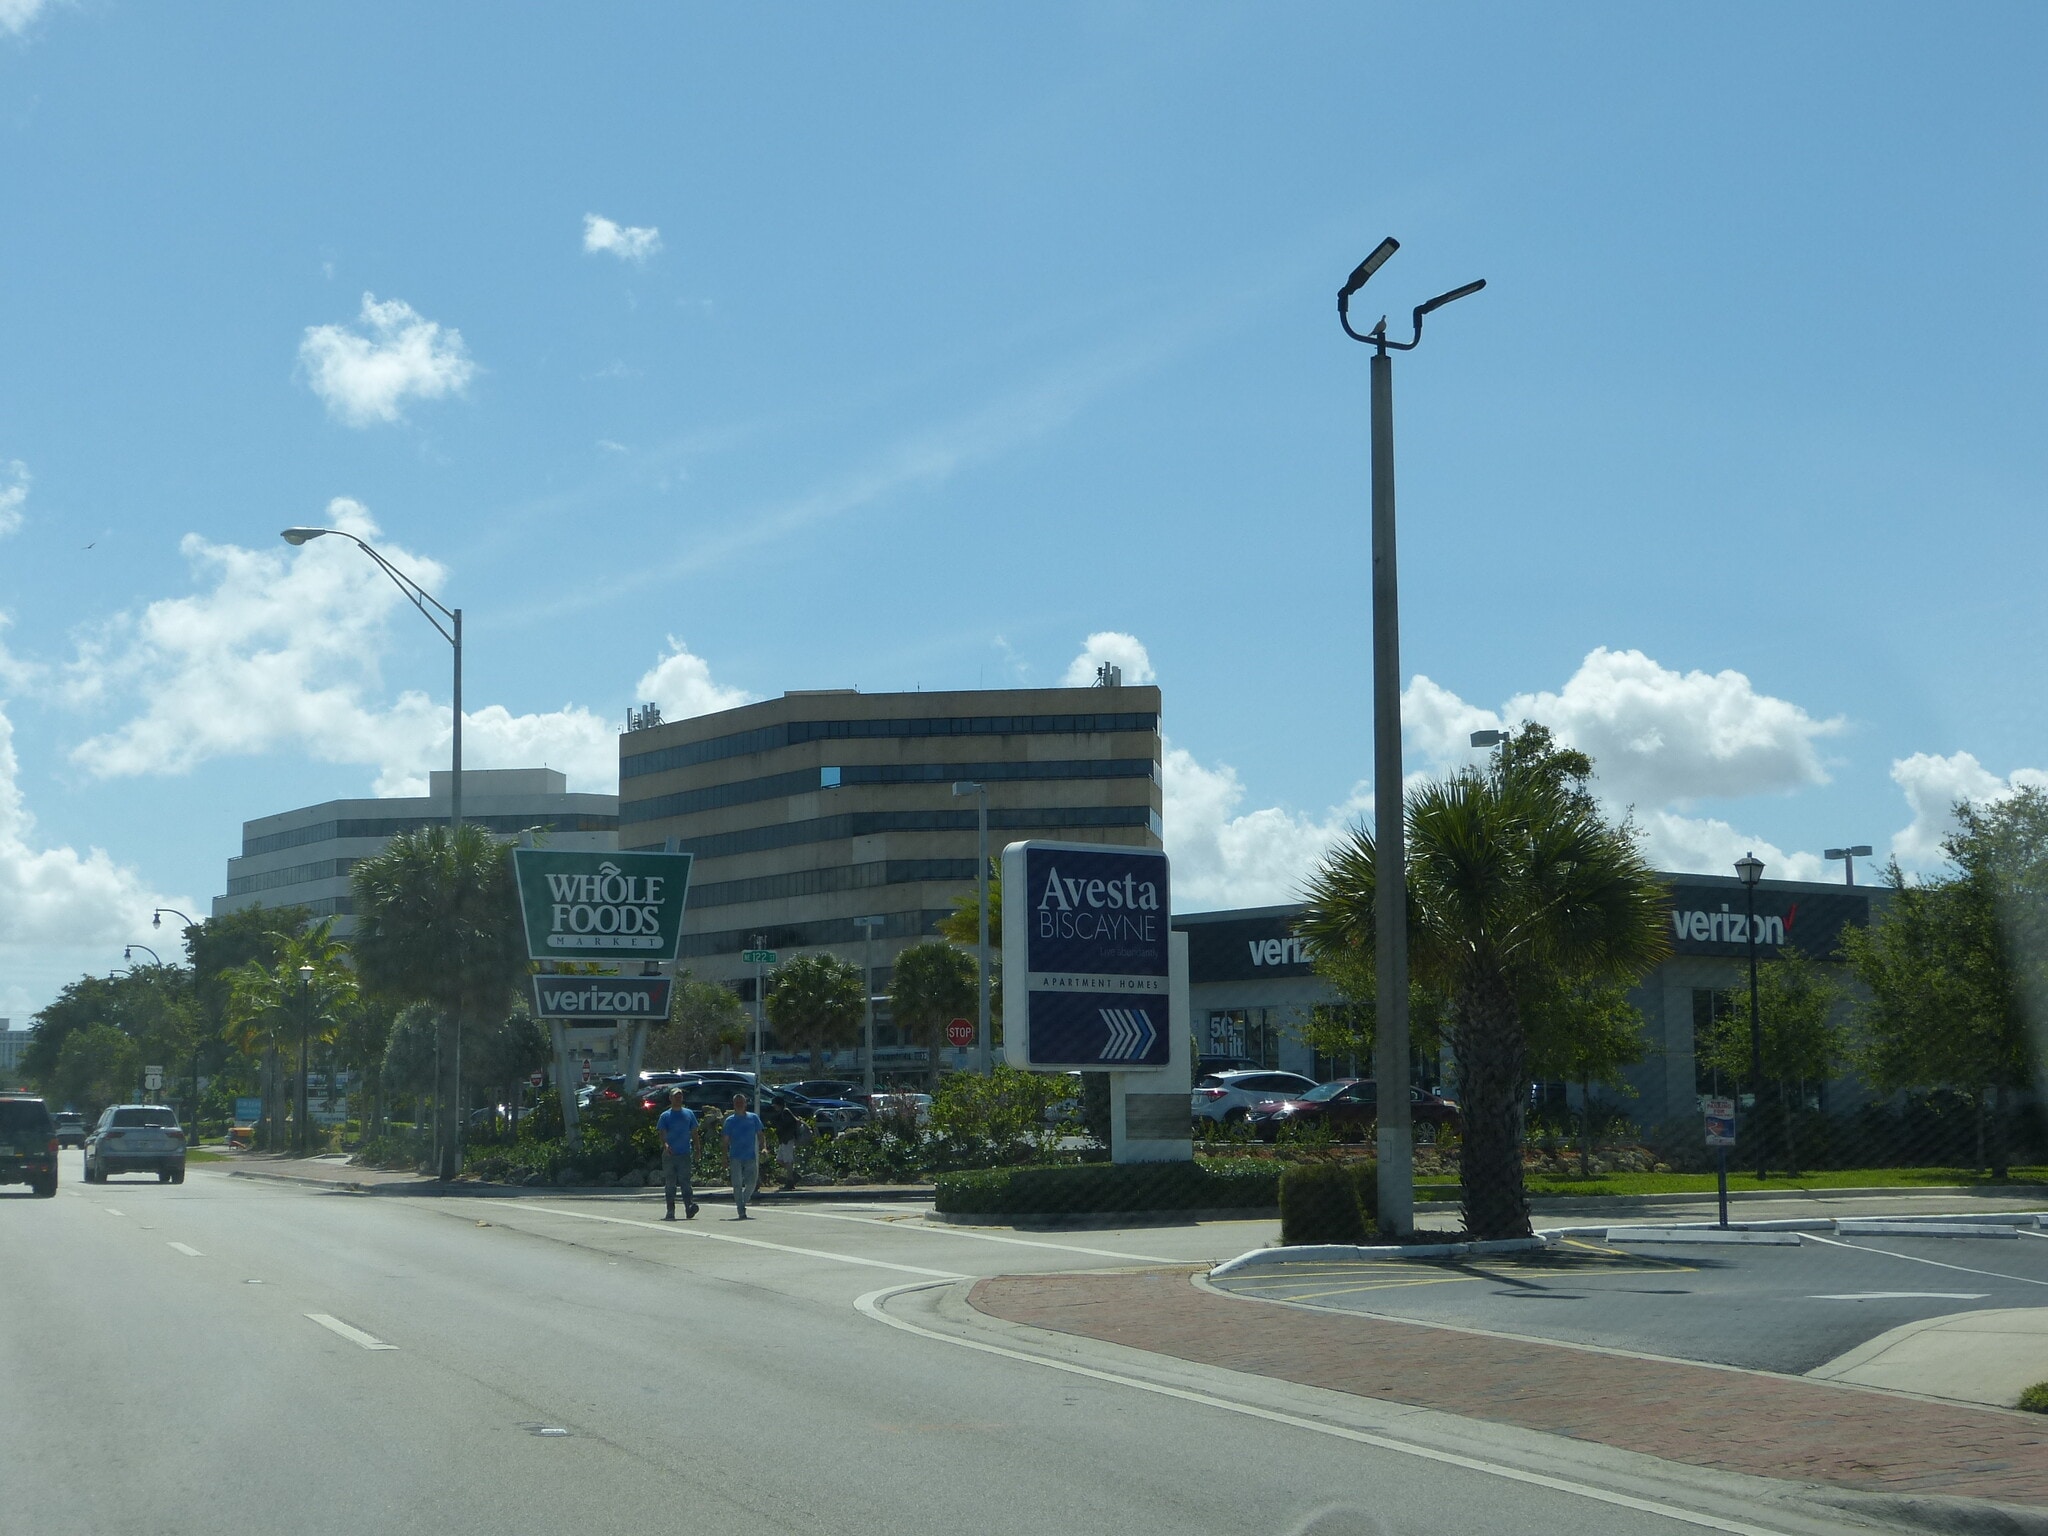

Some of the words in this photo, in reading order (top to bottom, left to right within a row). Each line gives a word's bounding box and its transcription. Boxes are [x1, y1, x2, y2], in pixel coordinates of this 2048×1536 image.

[545, 861, 665, 904] WHOLE
[1037, 866, 1159, 911] Avesta
[551, 904, 660, 934] FOODS
[1040, 911, 1156, 942] BISCAYNE
[1672, 903, 1784, 946] verizon
[556, 937, 656, 947] MARKET
[752, 952, 766, 961] 122
[1043, 977, 1112, 988] APARTMENT
[1119, 981, 1158, 989] HOMES
[543, 985, 650, 1011] verizon
[949, 1027, 971, 1038] STOP
[1210, 1016, 1233, 1038] 5G
